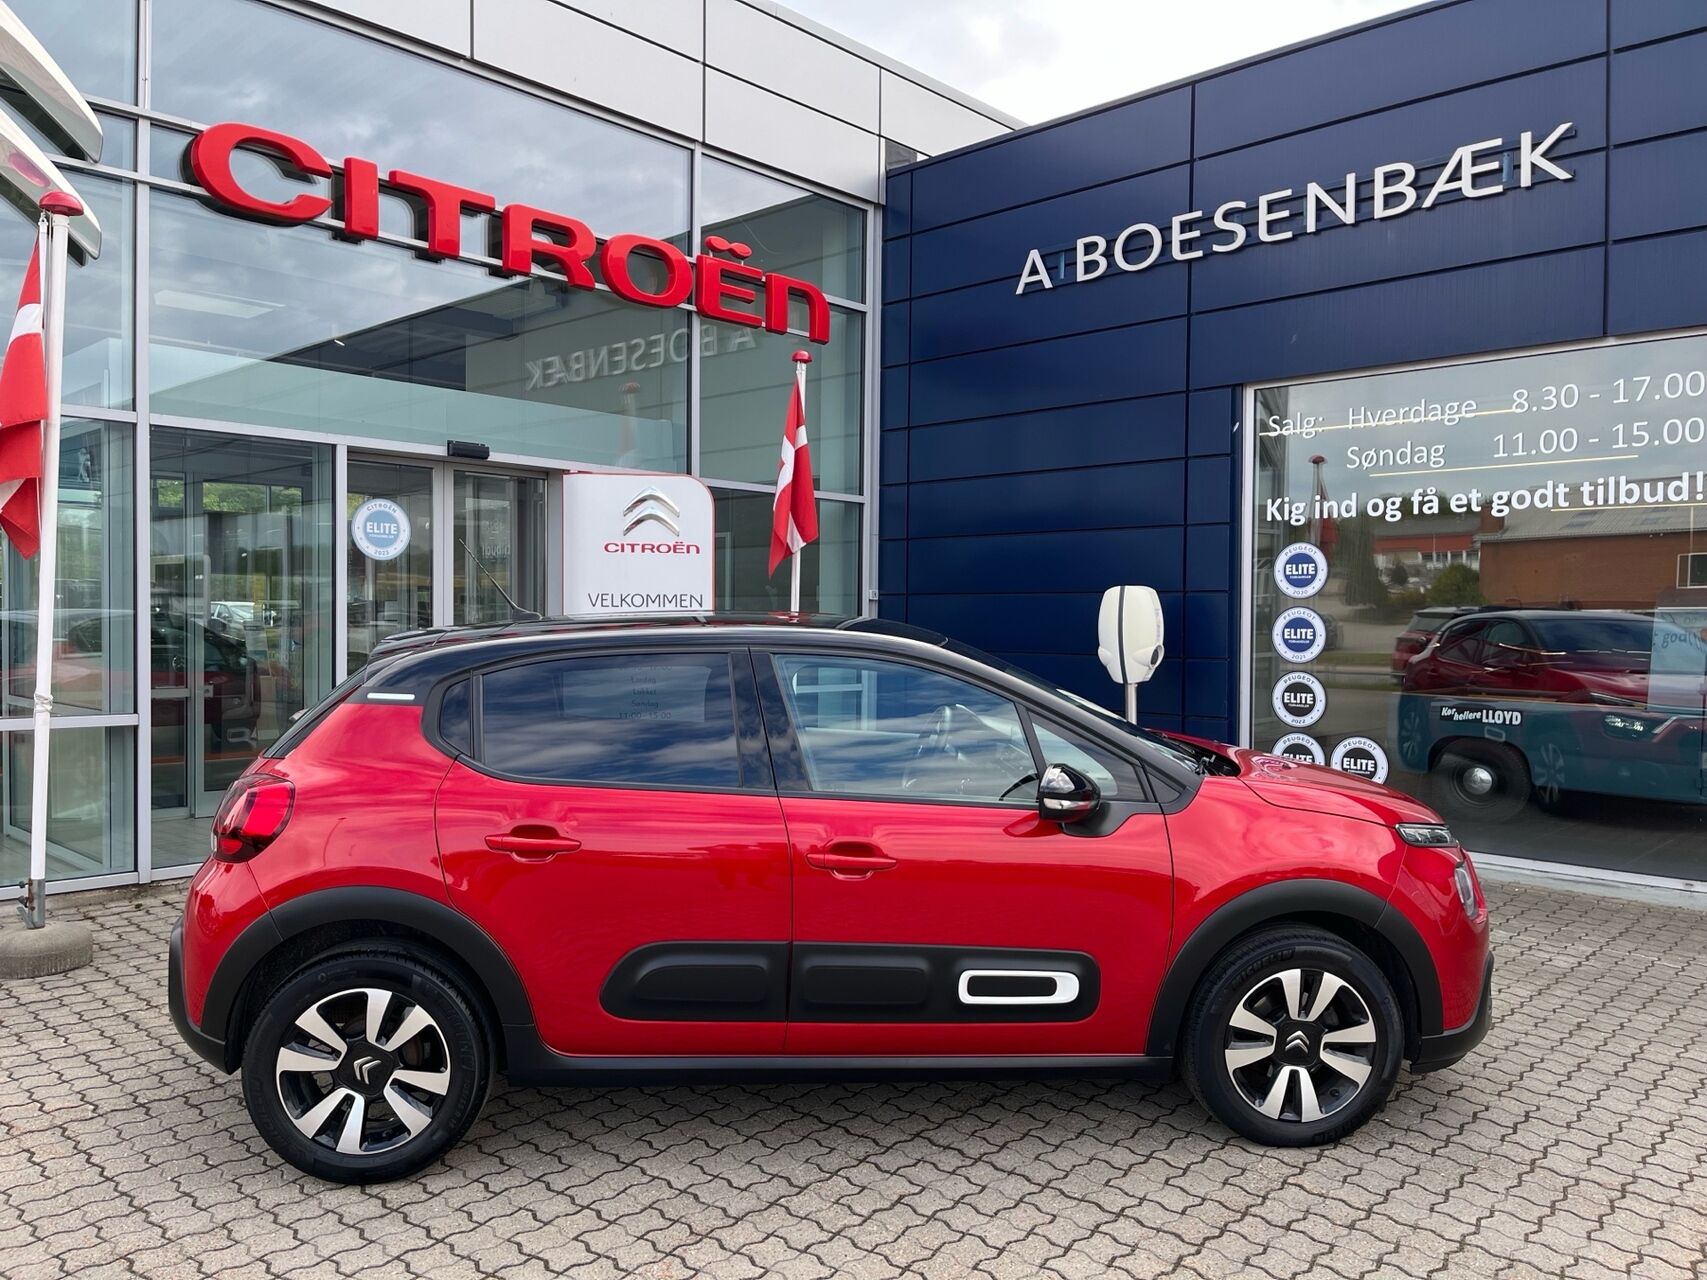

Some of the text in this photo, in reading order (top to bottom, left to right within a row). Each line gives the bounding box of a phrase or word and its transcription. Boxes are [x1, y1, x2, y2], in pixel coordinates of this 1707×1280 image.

[1015, 121, 1575, 296] A BOESENBÆK
[1268, 411, 1325, 438] Salg:
[1349, 398, 1477, 430] Hverdage
[1512, 383, 1579, 413] 8.30
[1612, 370, 1706, 404] 17.00
[1346, 440, 1446, 470] Søndag
[1493, 427, 1578, 458] 11.00
[1611, 417, 1706, 449] 15.00
[1266, 471, 1705, 526] Kig ind og få et godt tilbud!
[366, 521, 398, 535] ELITE
[1284, 545, 1317, 557] PEUGEOT
[1285, 563, 1316, 576] ELITE
[588, 593, 703, 608] VELKOMMEN
[1283, 609, 1316, 621] PEUGEOT
[1284, 628, 1314, 640] ELITE
[1283, 674, 1316, 685] PEUGEOT
[1283, 692, 1314, 705] ELITE
[1482, 709, 1522, 726] LLOYD
[1282, 735, 1315, 747] PEUGEOT
[1343, 739, 1377, 751] PEUGEOT
[1343, 757, 1375, 771] ELITE
